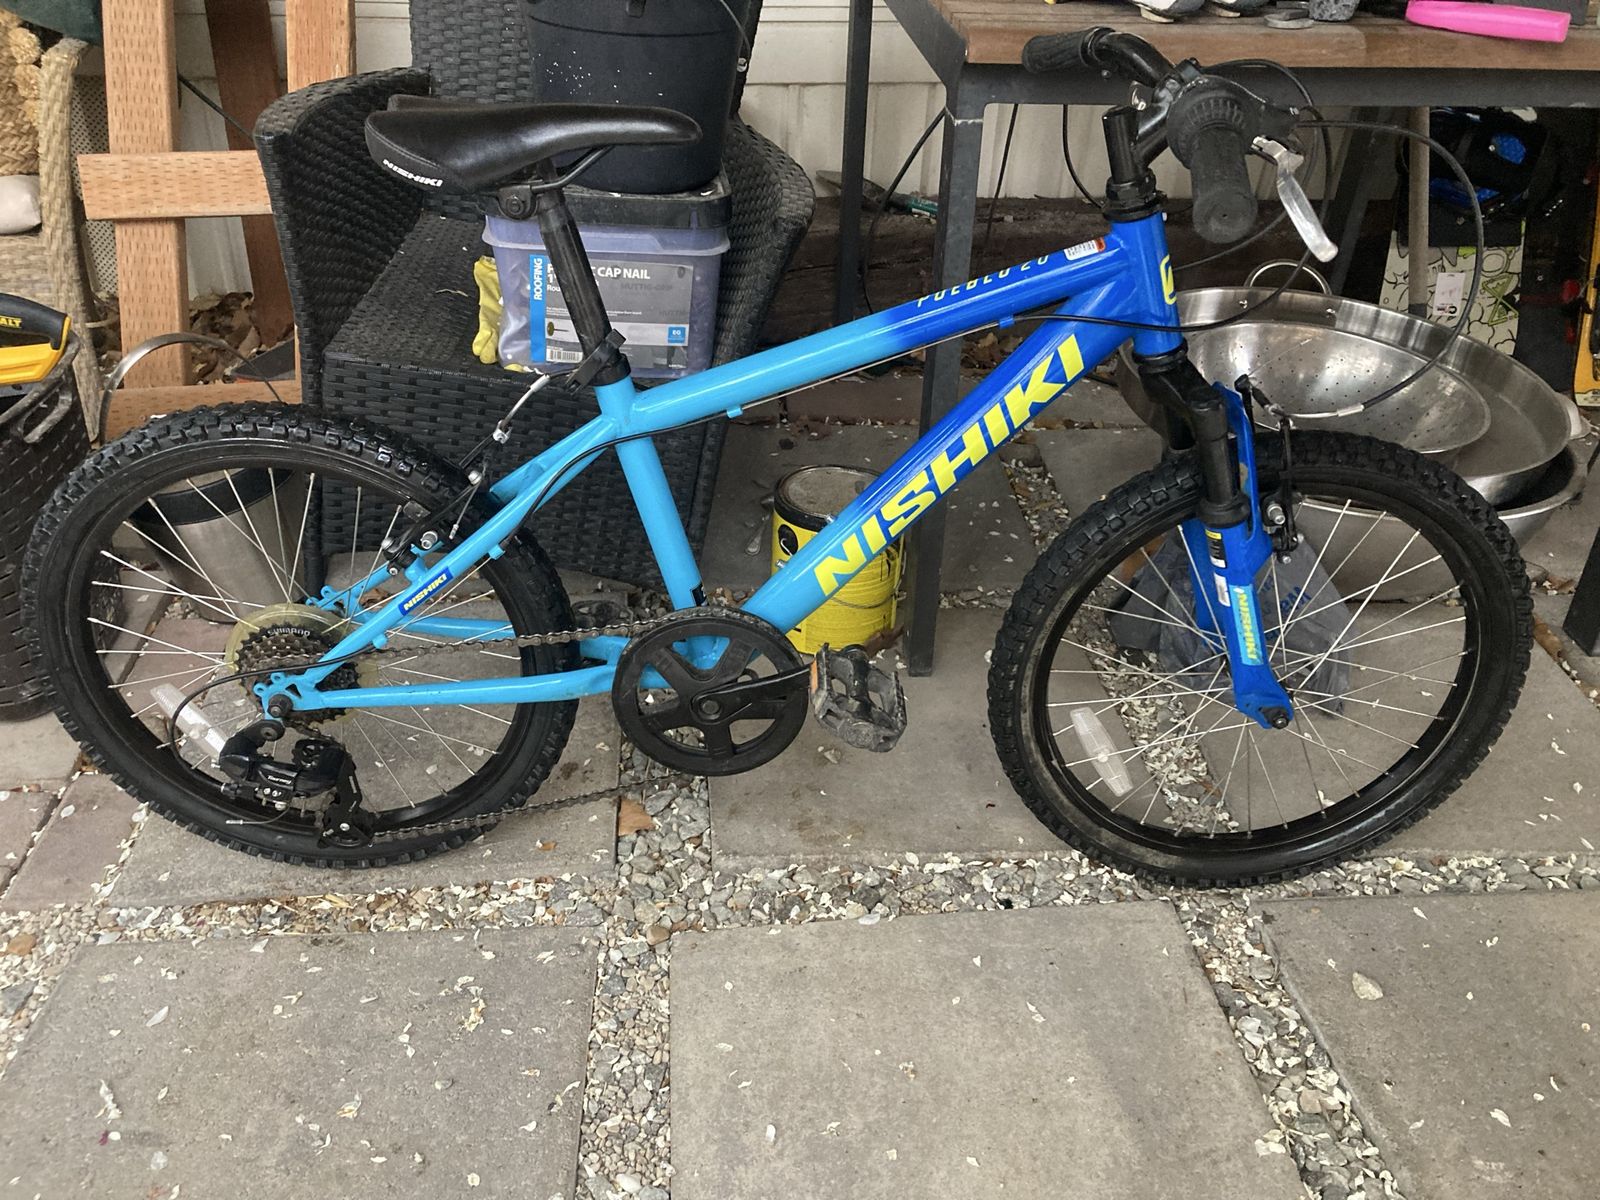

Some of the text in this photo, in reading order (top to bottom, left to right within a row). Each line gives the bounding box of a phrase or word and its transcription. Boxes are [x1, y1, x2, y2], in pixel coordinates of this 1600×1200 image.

[383, 159, 443, 187] NISHIKI
[533, 258, 543, 301] ROOFING
[597, 266, 622, 278] CAP
[623, 267, 651, 280] NAIL
[814, 333, 1085, 597] NISHIKI
[403, 573, 447, 611] NISHIKI
[1237, 593, 1258, 660] NISHIKI
